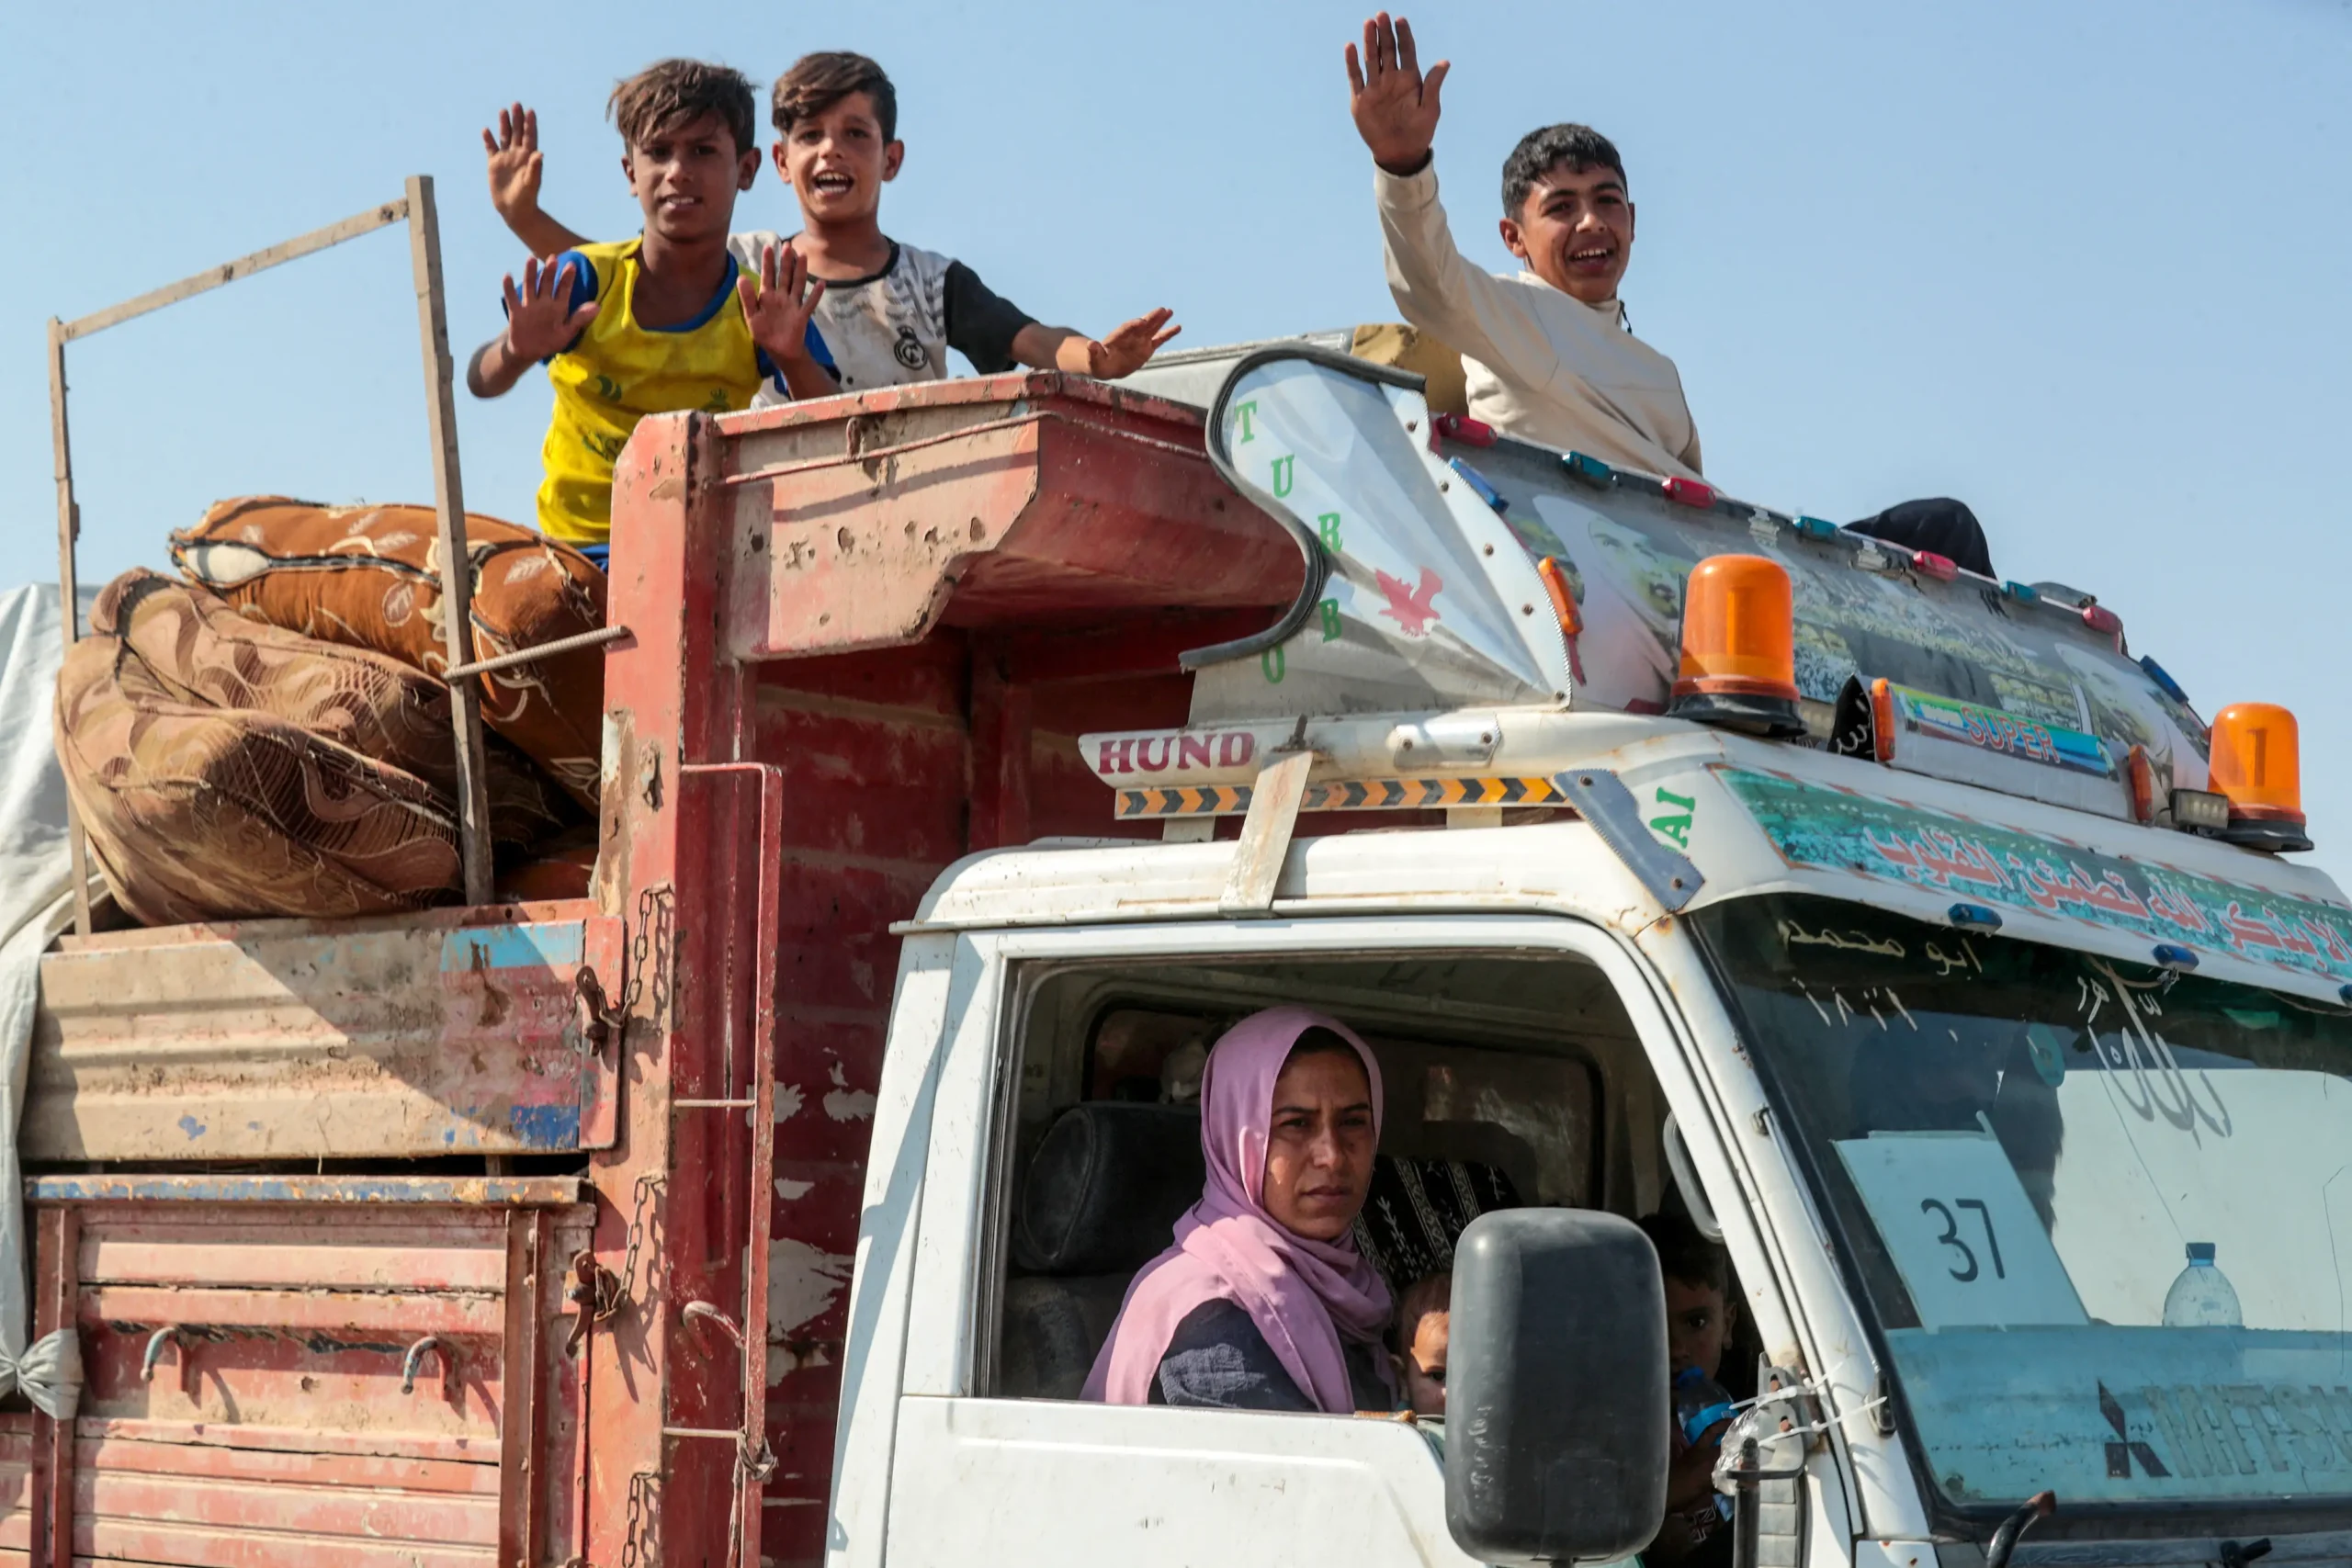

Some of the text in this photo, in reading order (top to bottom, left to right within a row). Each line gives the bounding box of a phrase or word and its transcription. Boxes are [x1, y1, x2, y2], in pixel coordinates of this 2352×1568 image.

[1098, 732, 1255, 774] HUND
[1960, 705, 2061, 764] SUPER
[1649, 786, 1696, 852] AI
[1862, 826, 2015, 889] القلوب
[2143, 869, 2215, 935] الله
[1921, 1198, 2006, 1282] 37
